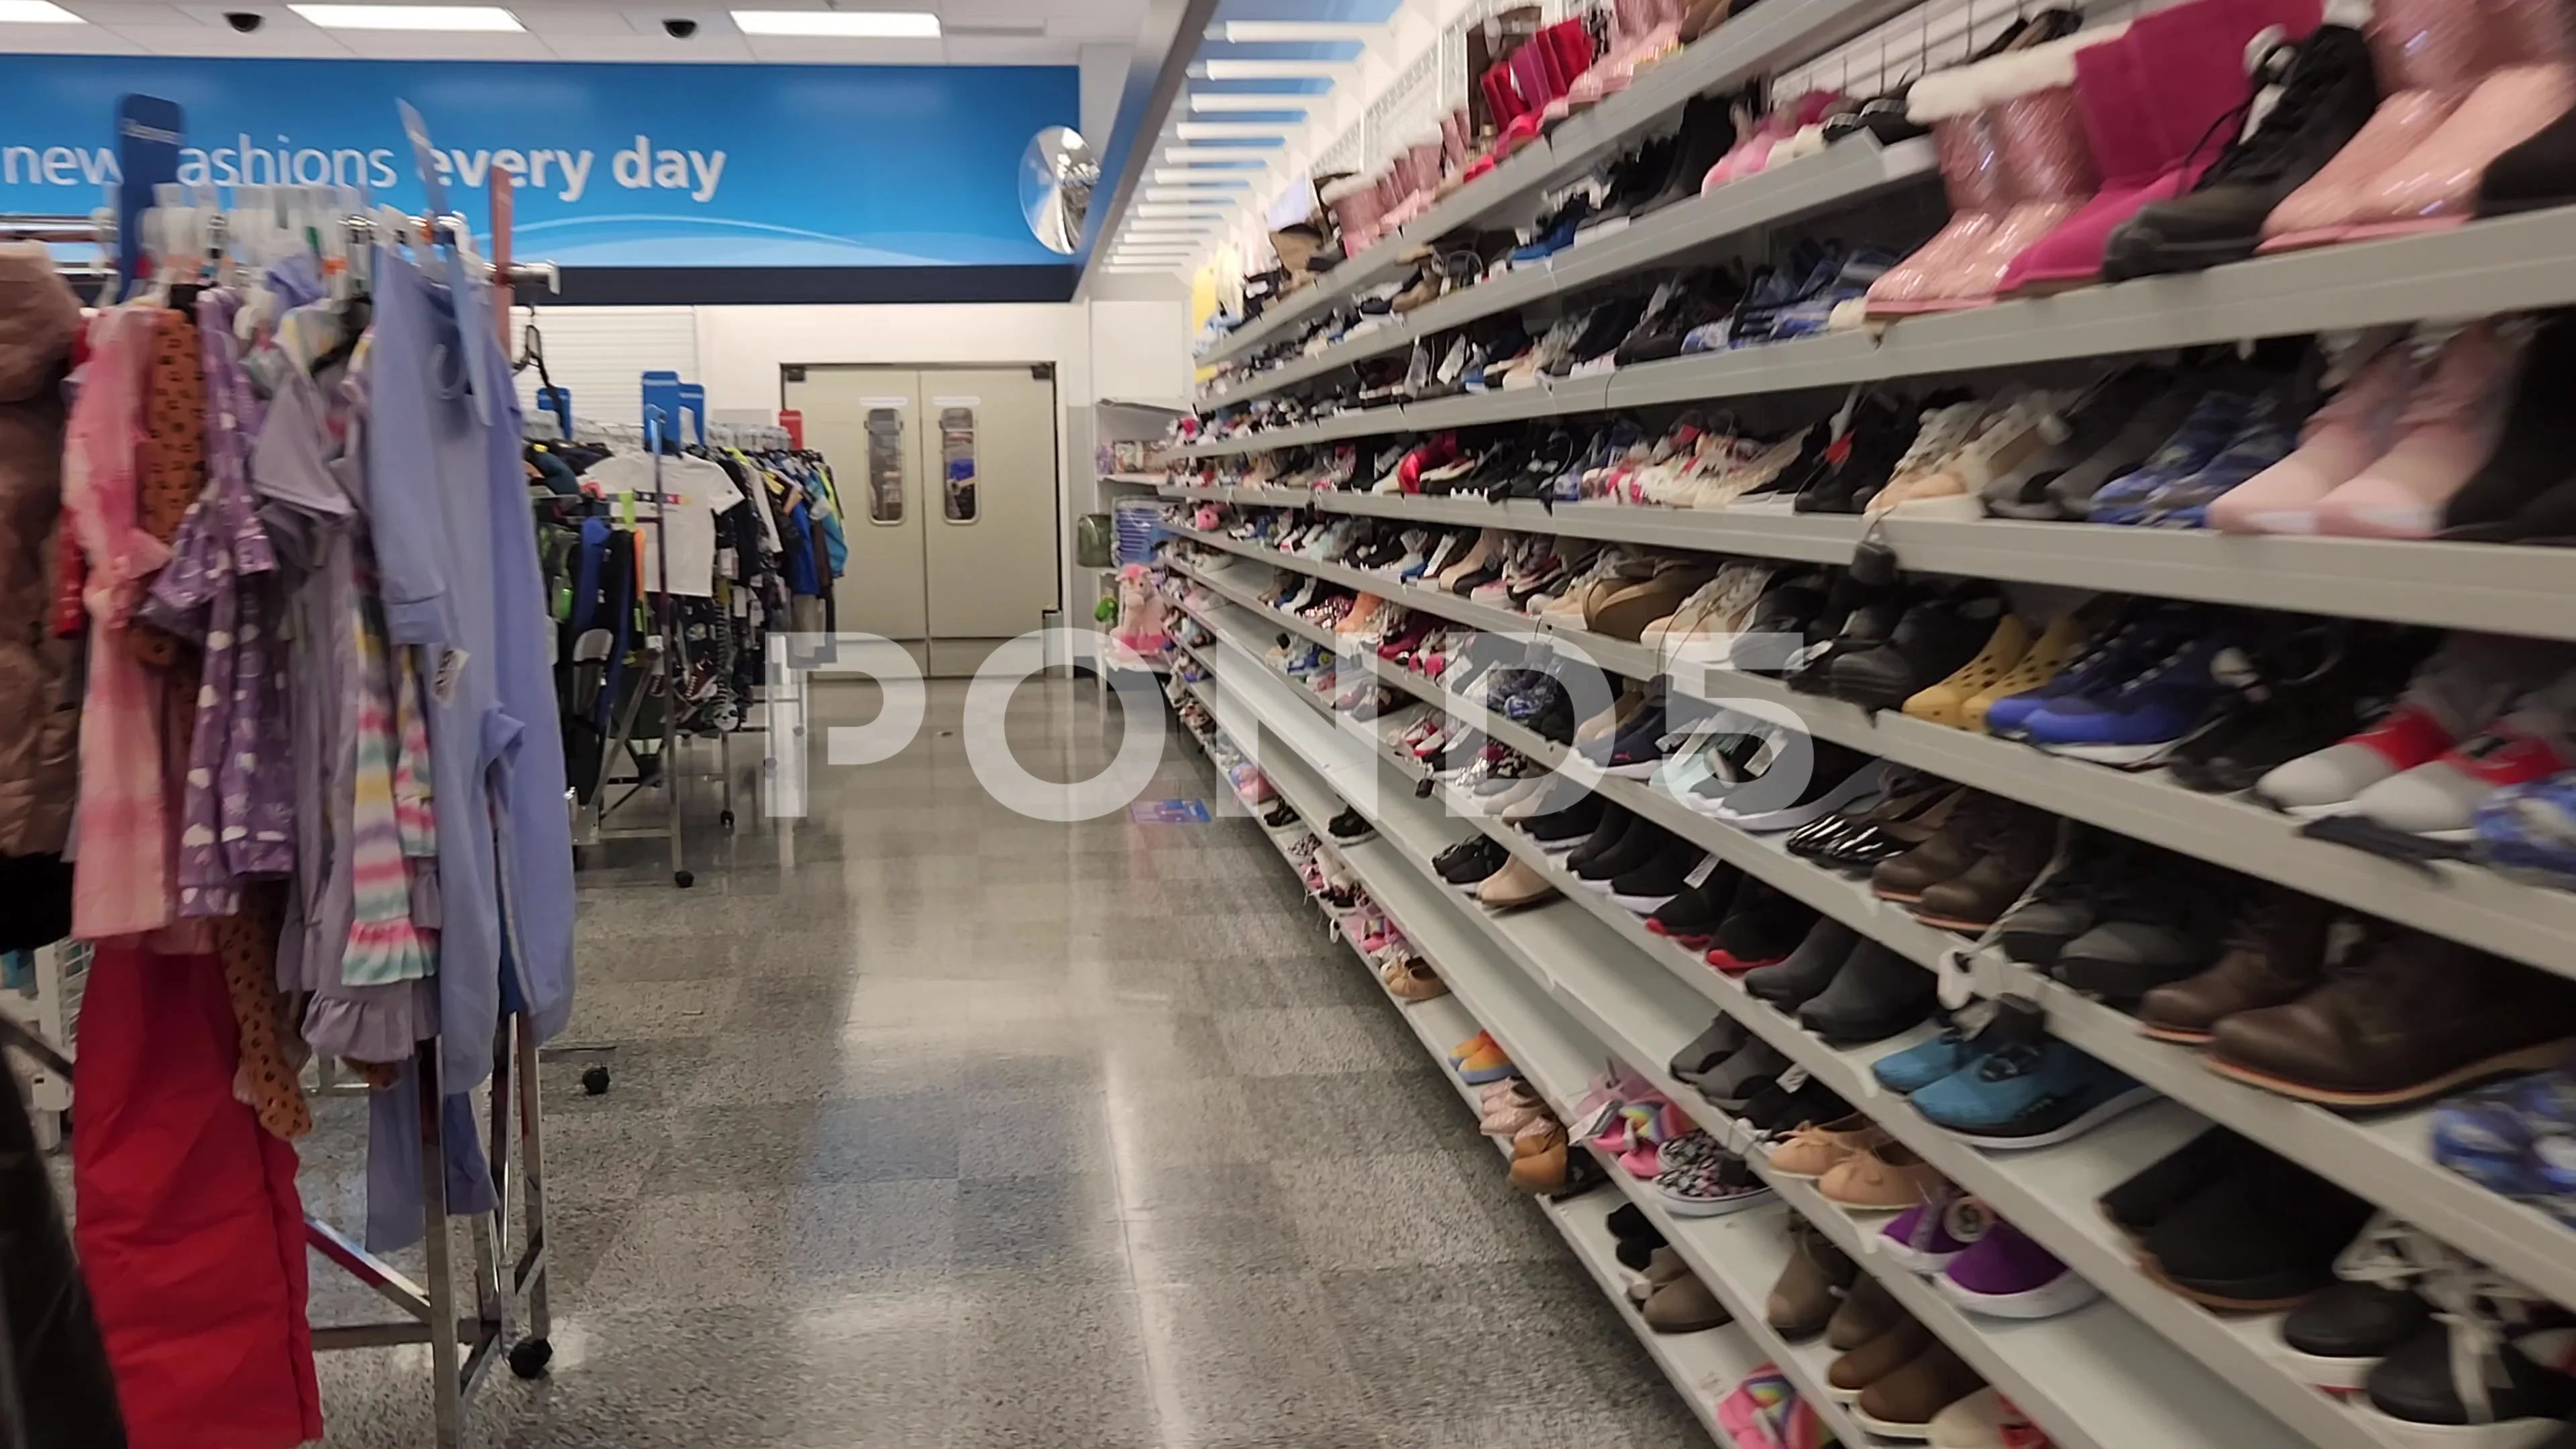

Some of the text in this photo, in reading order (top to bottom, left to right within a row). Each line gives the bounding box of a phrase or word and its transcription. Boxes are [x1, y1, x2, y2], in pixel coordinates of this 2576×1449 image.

[3, 134, 727, 203] new ashions every day
